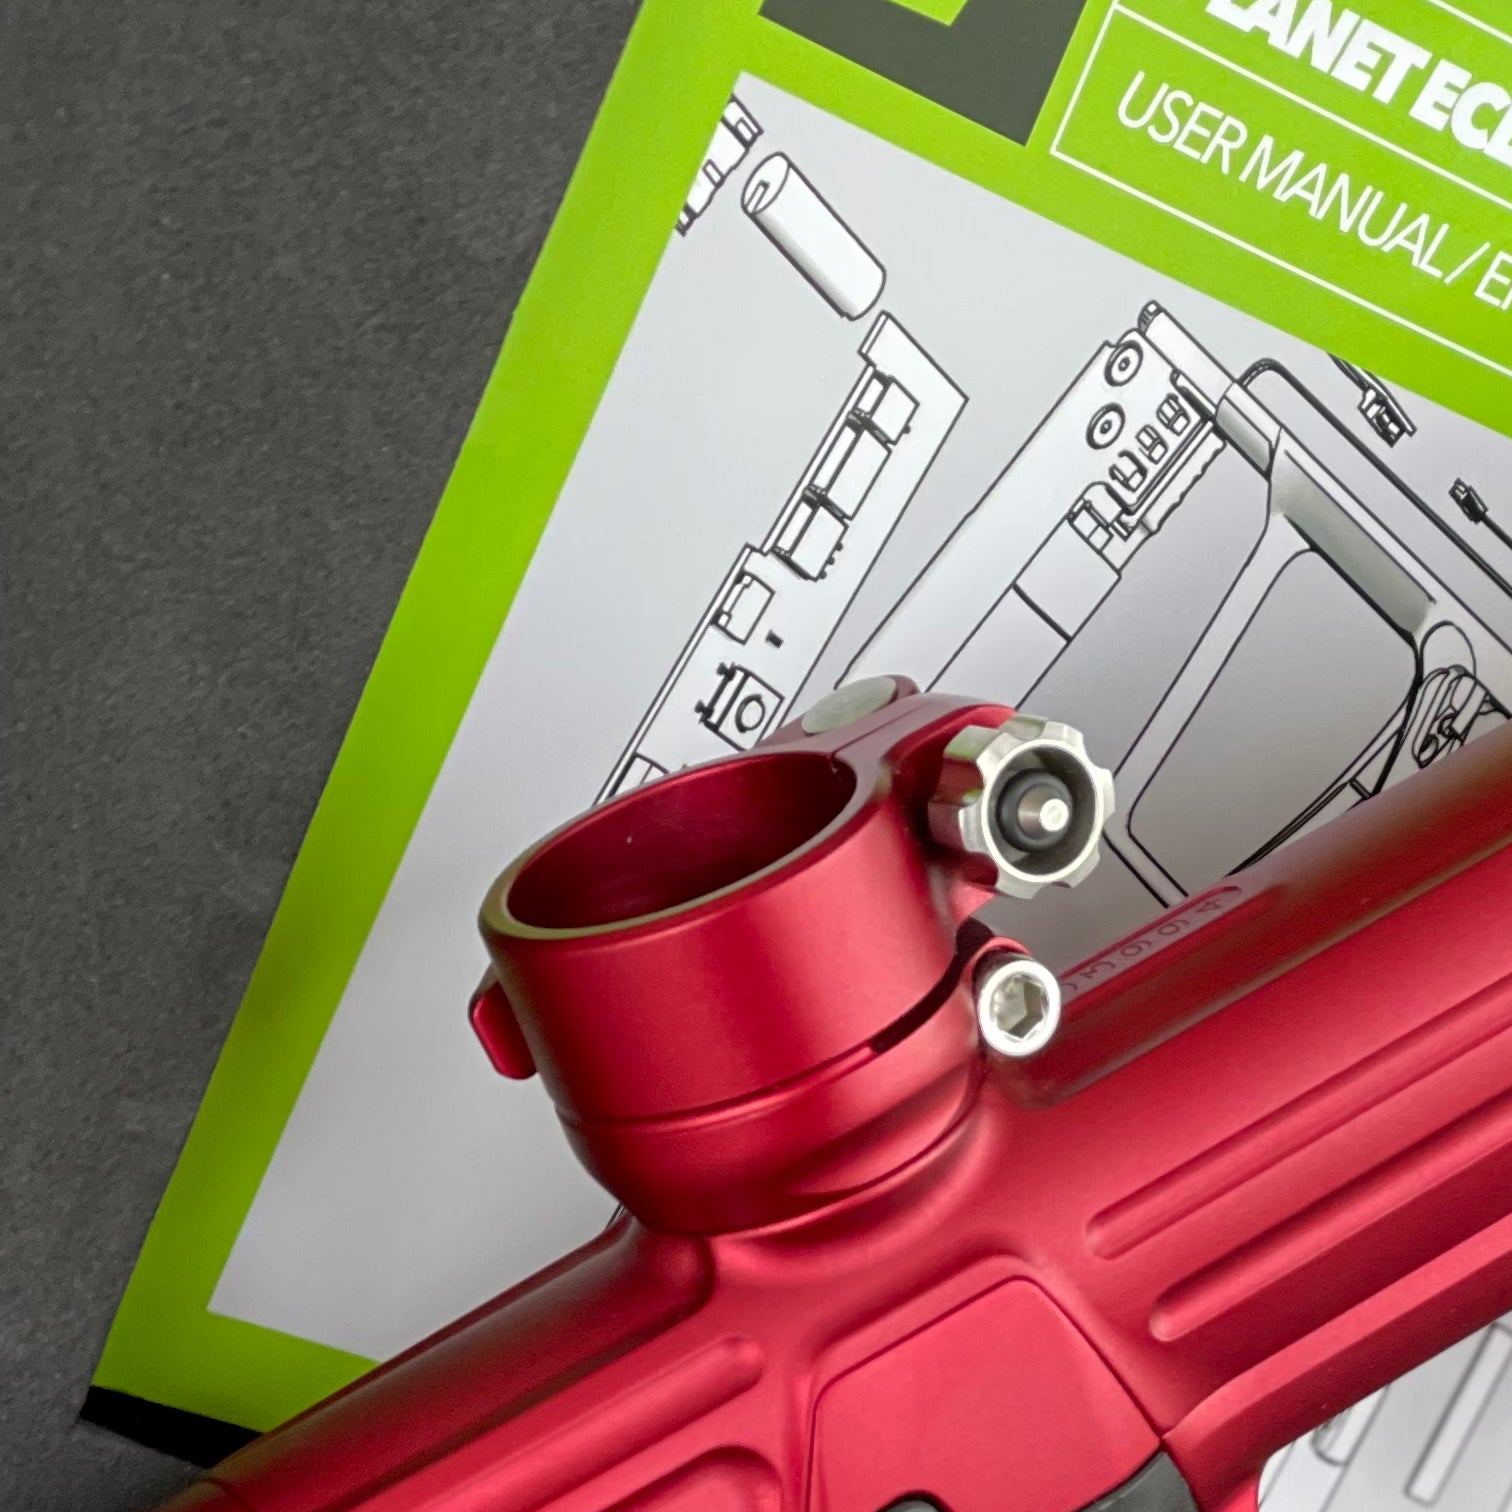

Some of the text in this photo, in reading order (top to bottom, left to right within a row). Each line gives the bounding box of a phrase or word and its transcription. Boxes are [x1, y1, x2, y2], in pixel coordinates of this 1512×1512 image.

[1117, 70, 1248, 175] USER
[1239, 133, 1449, 278] MANUAL
[1444, 242, 1492, 285] /
